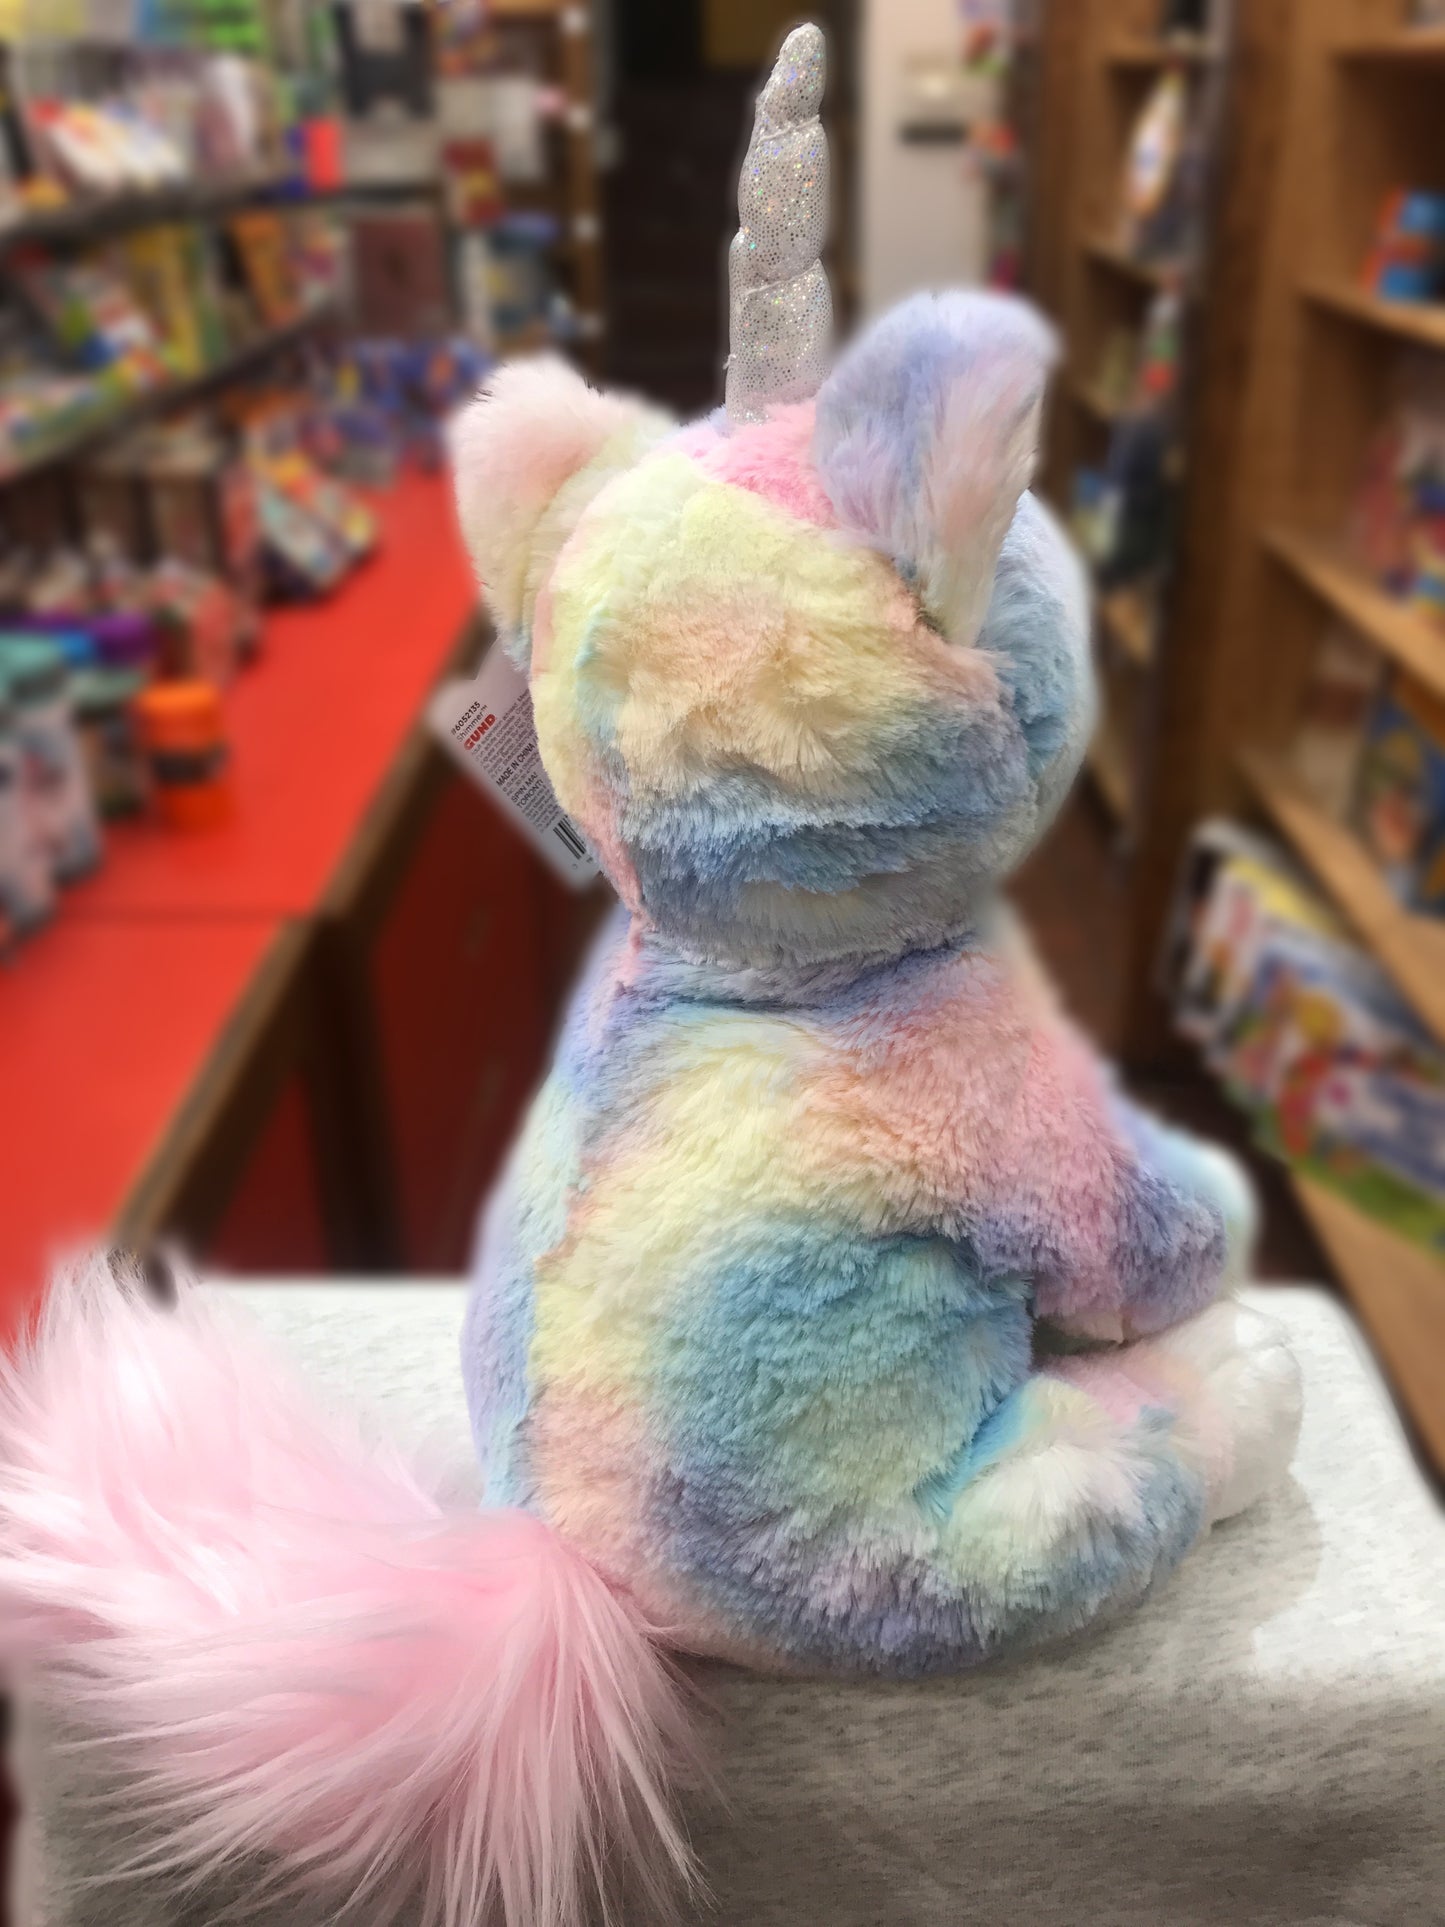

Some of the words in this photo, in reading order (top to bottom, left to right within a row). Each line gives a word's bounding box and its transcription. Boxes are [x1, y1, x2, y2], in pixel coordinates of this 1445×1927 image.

[450, 699, 481, 736] #6052135
[463, 712, 497, 751] GUND
[495, 766, 514, 787] MADE
[509, 759, 519, 770] IN
[515, 741, 535, 764] CHINA
[510, 783, 527, 803] SPIN
